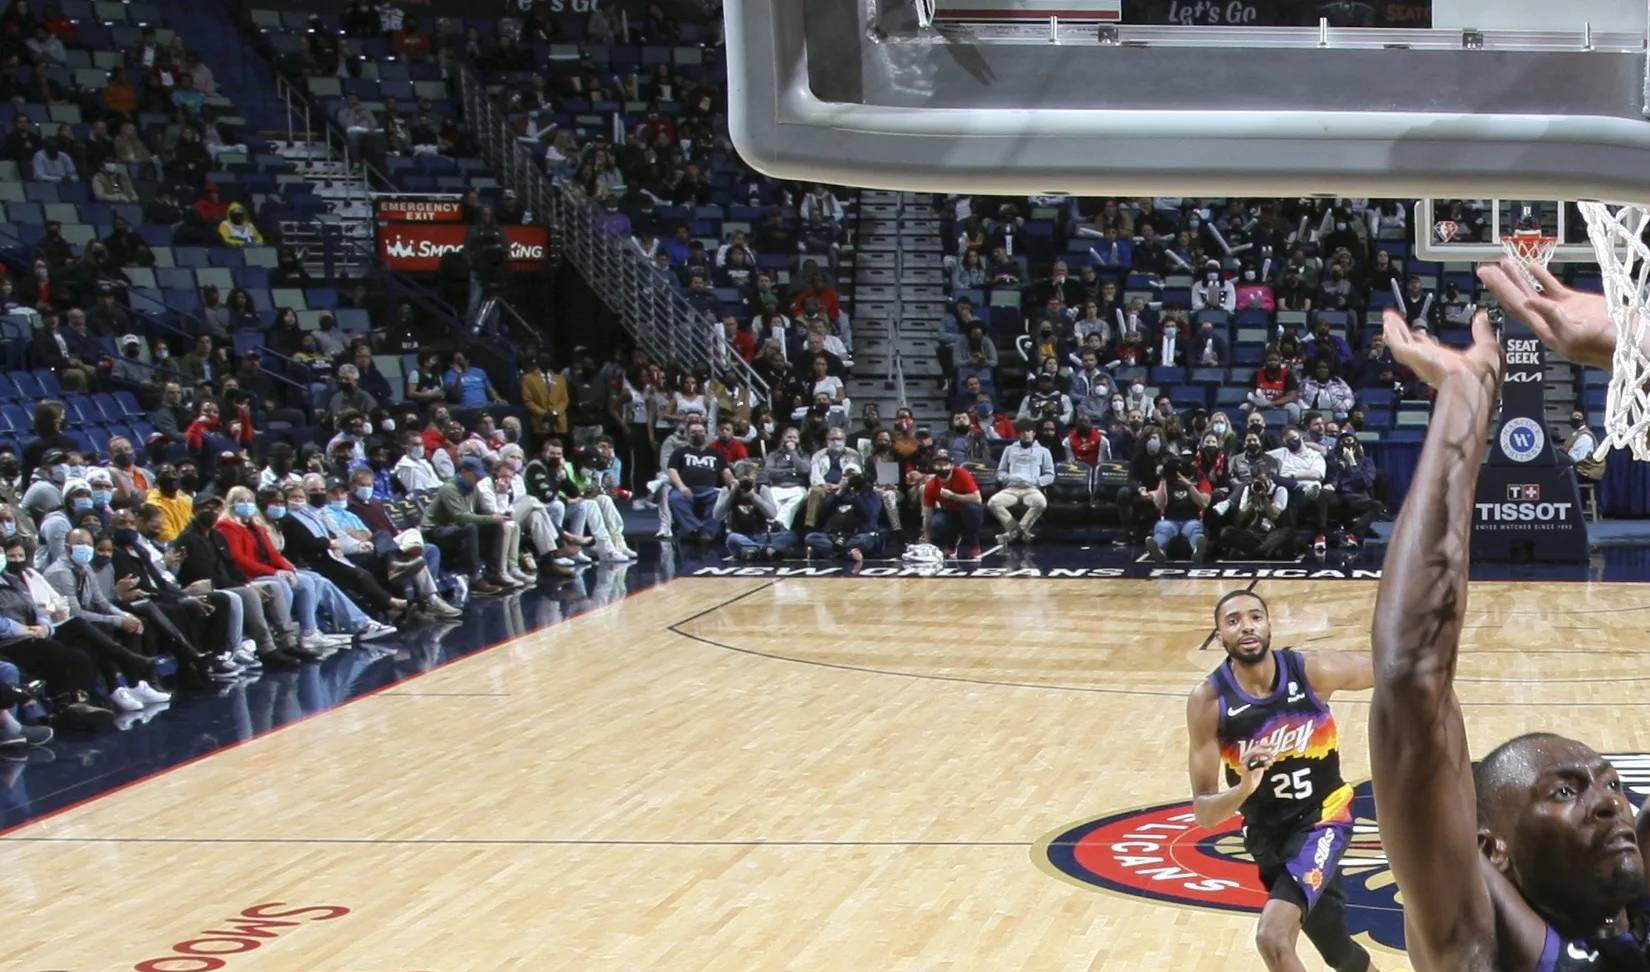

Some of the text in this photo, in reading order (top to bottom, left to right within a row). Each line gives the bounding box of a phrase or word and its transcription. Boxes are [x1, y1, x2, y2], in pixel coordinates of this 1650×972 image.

[380, 202, 460, 213] EMERGENCY
[406, 212, 436, 221] EXIT
[1507, 339, 1539, 351] SEAT
[1506, 352, 1540, 365] GEEK
[684, 453, 717, 468] TMT
[1475, 503, 1572, 521] TISSOT
[693, 565, 1383, 579] NEW ORLEANS PELICAN
[1270, 767, 1313, 800] 25
